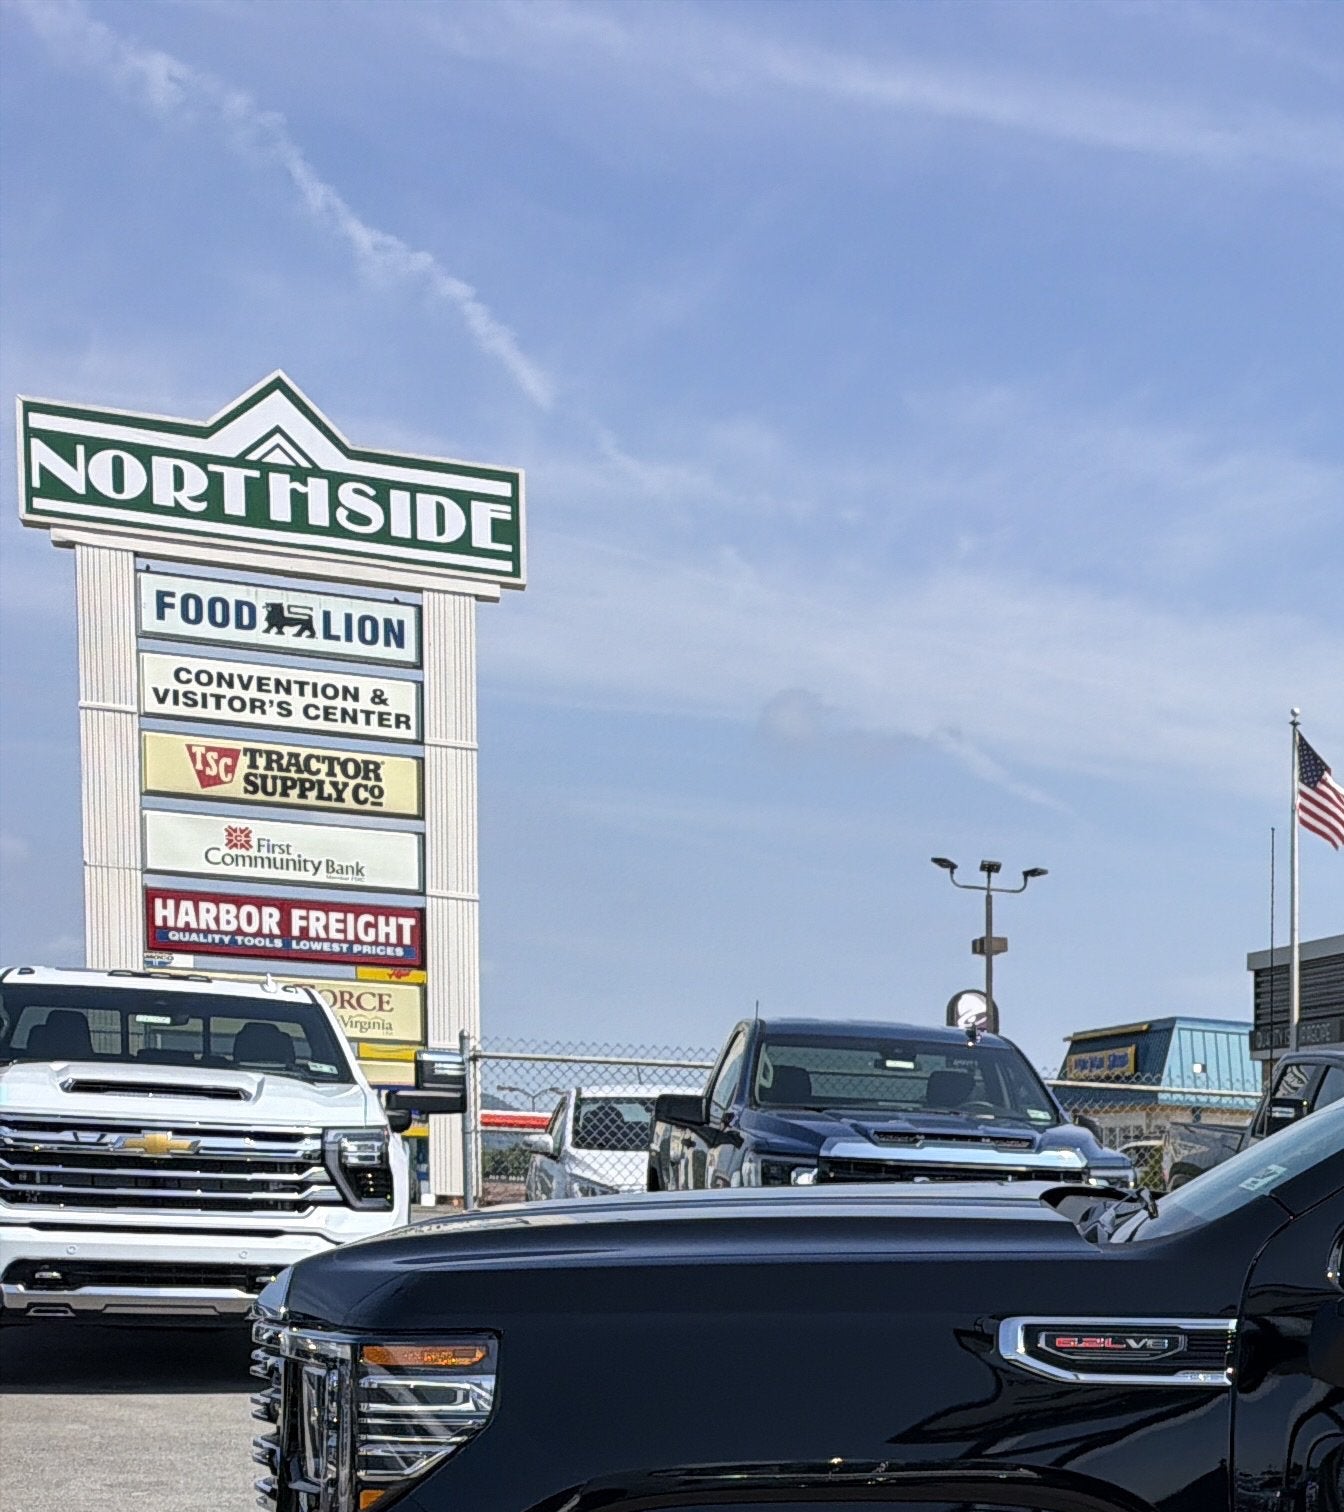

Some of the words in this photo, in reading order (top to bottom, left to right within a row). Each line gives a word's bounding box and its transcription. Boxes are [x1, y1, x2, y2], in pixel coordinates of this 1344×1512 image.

[30, 437, 513, 553] NORTHSIDE
[155, 590, 257, 631] FOOD
[322, 609, 406, 650] LION
[173, 666, 360, 703] CONVENTION
[370, 688, 390, 707] &
[152, 686, 293, 718] VISITOR'S
[302, 703, 412, 731] CENTER
[191, 746, 233, 783] TSC
[242, 746, 383, 783] TRACTOR
[243, 771, 350, 804] SUPPLY
[204, 846, 323, 877] Community
[325, 858, 366, 878] Bank
[257, 838, 292, 856] First
[154, 897, 281, 936] HARBOR
[290, 908, 416, 945] FREIGHT
[168, 930, 231, 945] QUALITY
[236, 935, 283, 949] TOOLS
[291, 939, 350, 954] LOWEST
[353, 943, 404, 957] PRICES
[339, 1014, 393, 1034] Virginia
